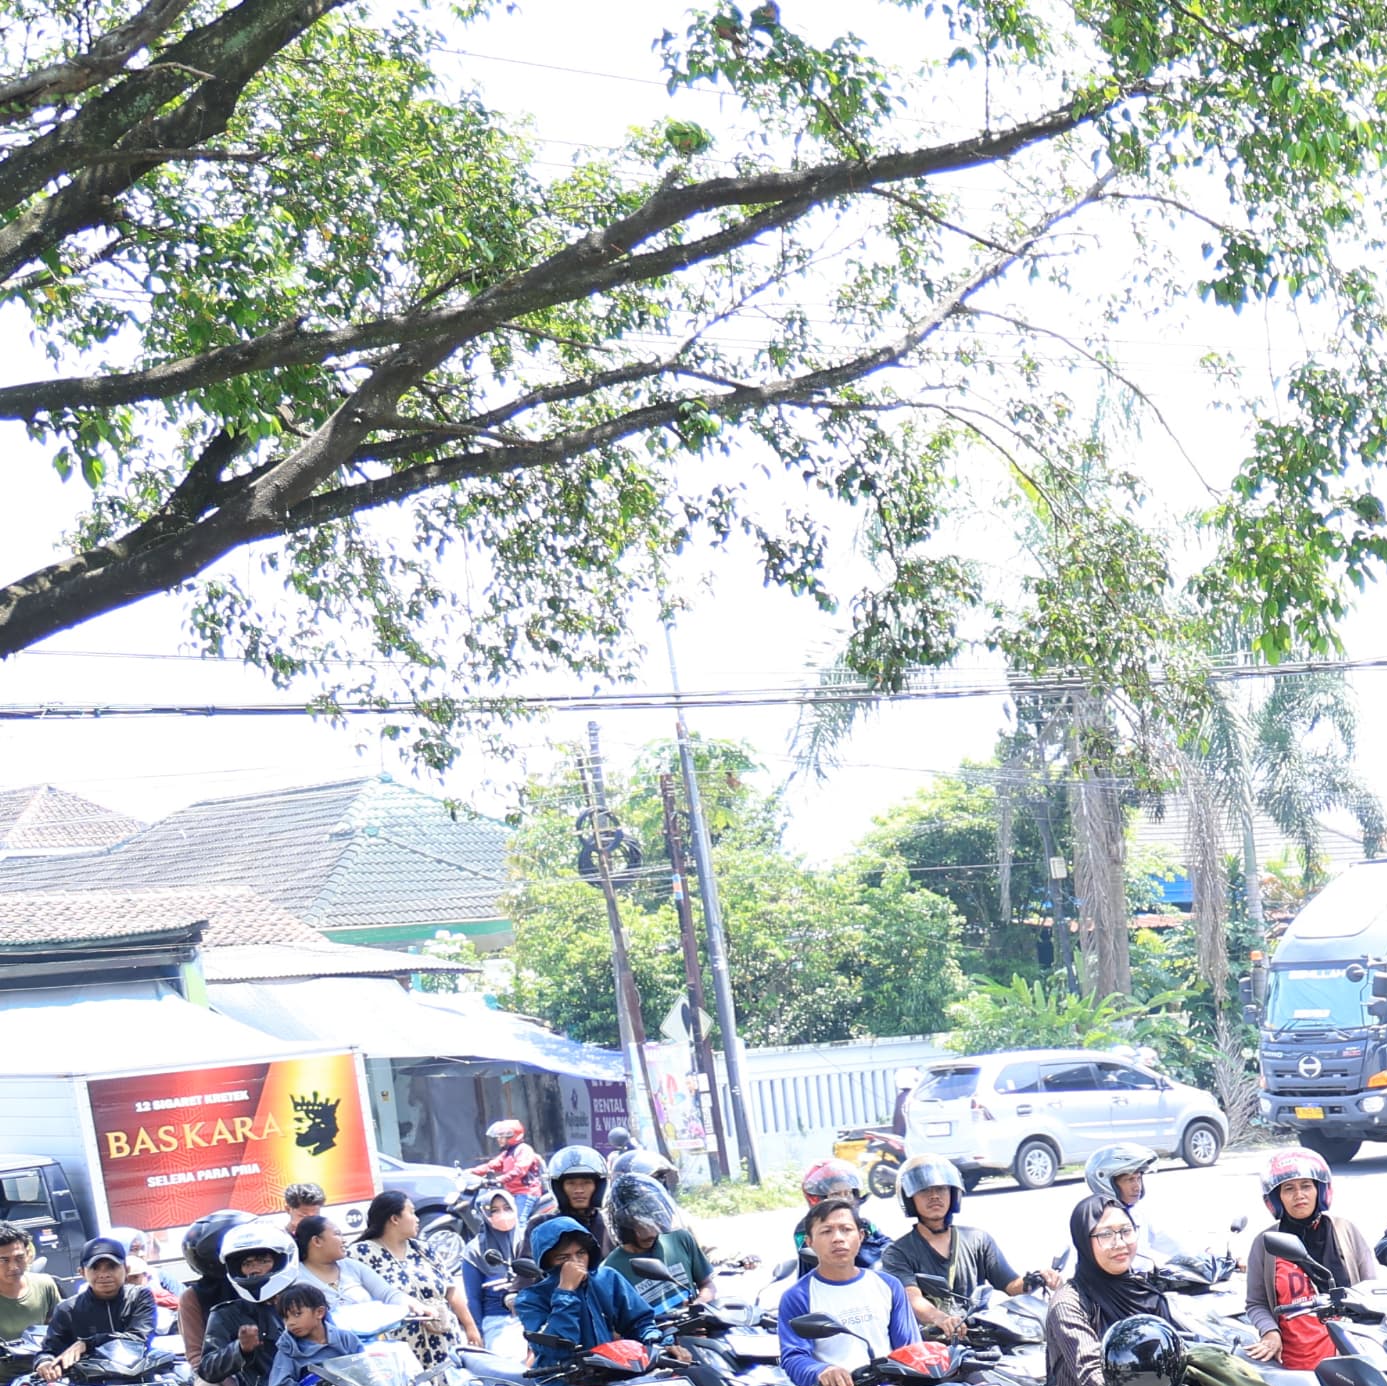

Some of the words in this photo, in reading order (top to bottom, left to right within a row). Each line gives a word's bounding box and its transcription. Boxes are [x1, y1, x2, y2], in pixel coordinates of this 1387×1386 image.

[135, 1100, 152, 1113] 12
[152, 1094, 204, 1111] SIGARET
[204, 1090, 250, 1105] KRETEK
[593, 1098, 625, 1113] RENTAL
[105, 1112, 286, 1159] BASKARA
[595, 1118, 602, 1131] &
[146, 1171, 196, 1188] SELERA
[198, 1166, 230, 1182] PARA
[231, 1162, 261, 1176] PRIA
